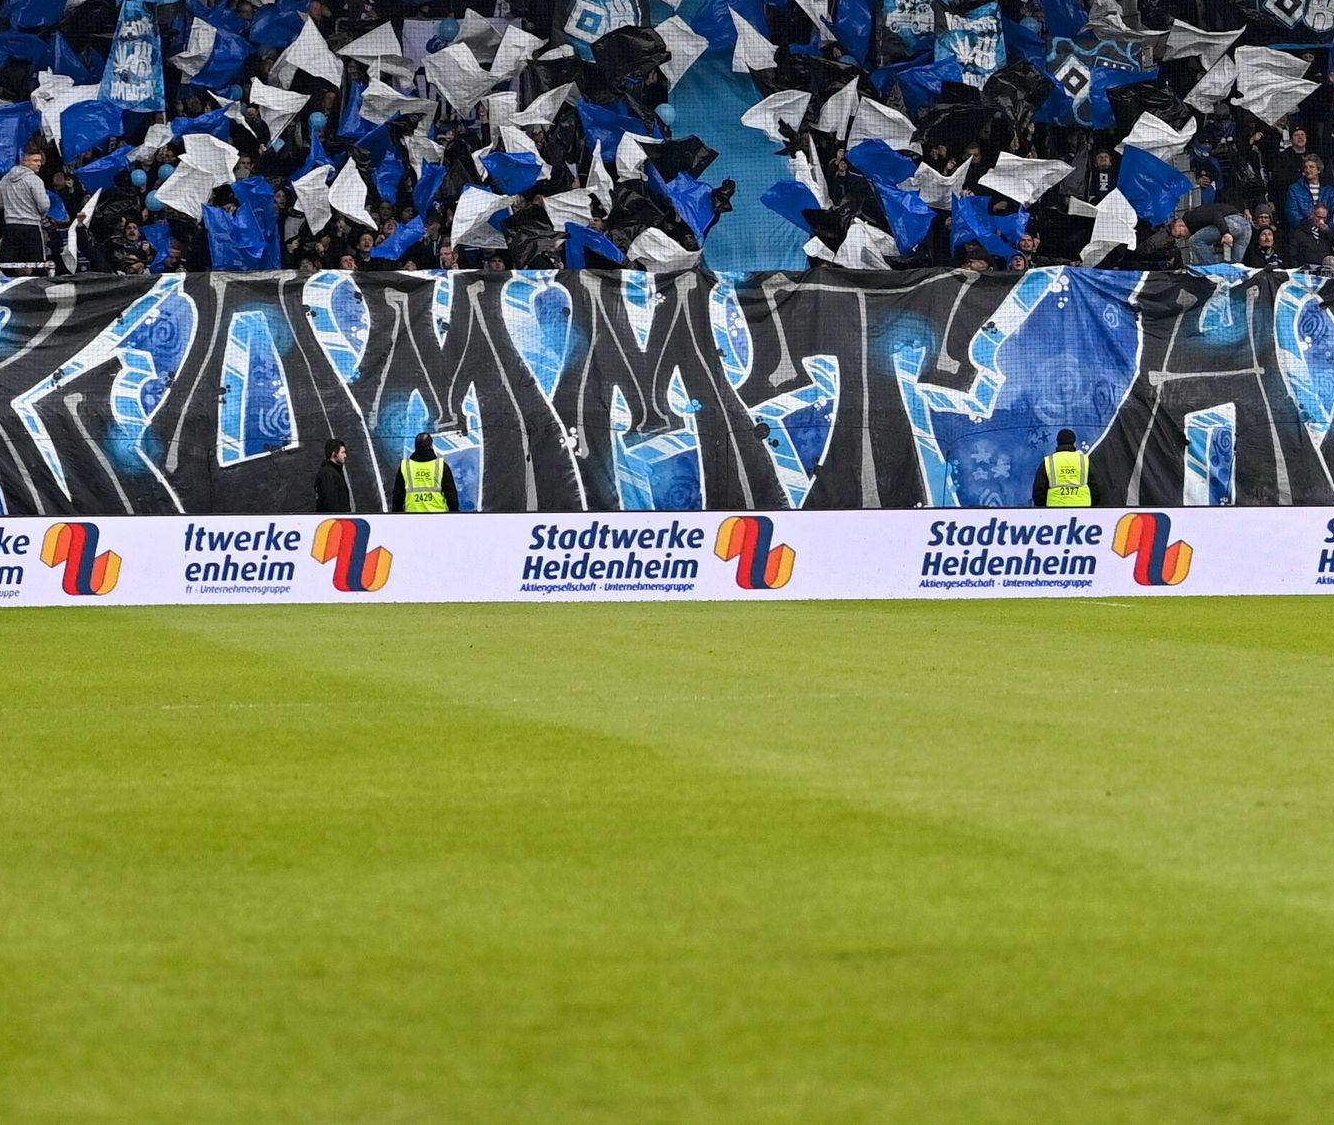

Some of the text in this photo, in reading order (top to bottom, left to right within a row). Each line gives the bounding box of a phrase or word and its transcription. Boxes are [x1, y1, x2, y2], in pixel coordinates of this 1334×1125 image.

[1060, 487, 1079, 496] 2377
[415, 494, 433, 503] 2429
[528, 520, 705, 551] Stadtwerke
[927, 517, 1103, 547] Stadtwerke
[522, 552, 699, 580] Heidenheim
[921, 548, 1097, 576] Heidenheim
[200, 585, 291, 595] Unternehmensgruppe
[519, 582, 695, 593] Aktiengesellschaft Unternehmensgruppe
[919, 578, 1093, 590] Aktiengesellschaft Unternehmensgruppe
